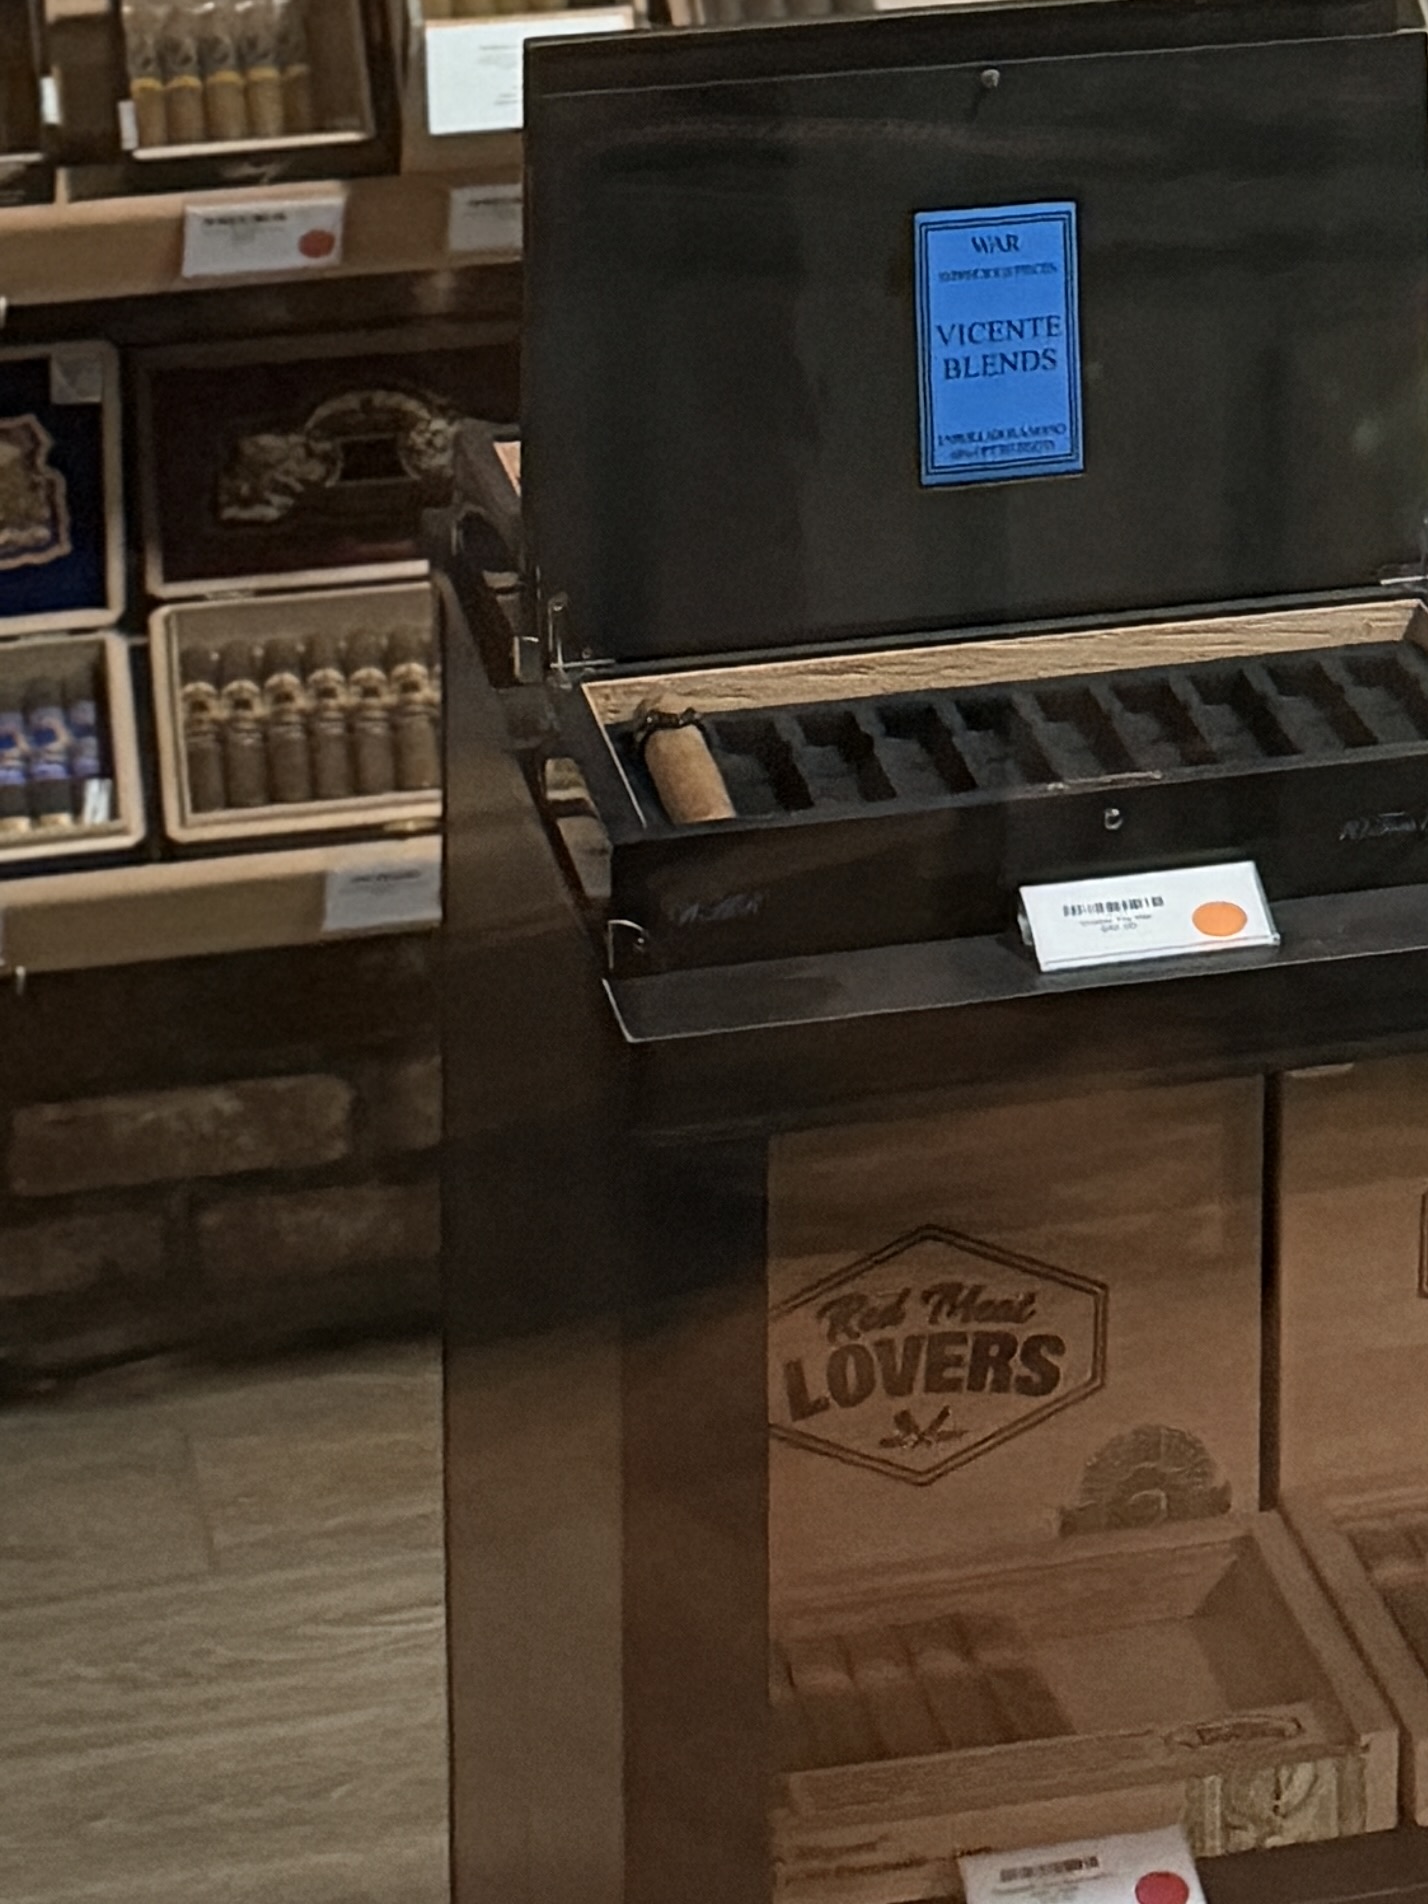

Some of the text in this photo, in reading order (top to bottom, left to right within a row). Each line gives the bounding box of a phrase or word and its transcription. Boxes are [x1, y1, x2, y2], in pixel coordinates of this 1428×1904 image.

[970, 232, 1020, 255] WAR
[935, 314, 1063, 346] VICENTE
[943, 348, 1058, 380] BLENDS
[817, 1278, 1039, 1347] Red Meat
[781, 1328, 1067, 1423] LOVERS
